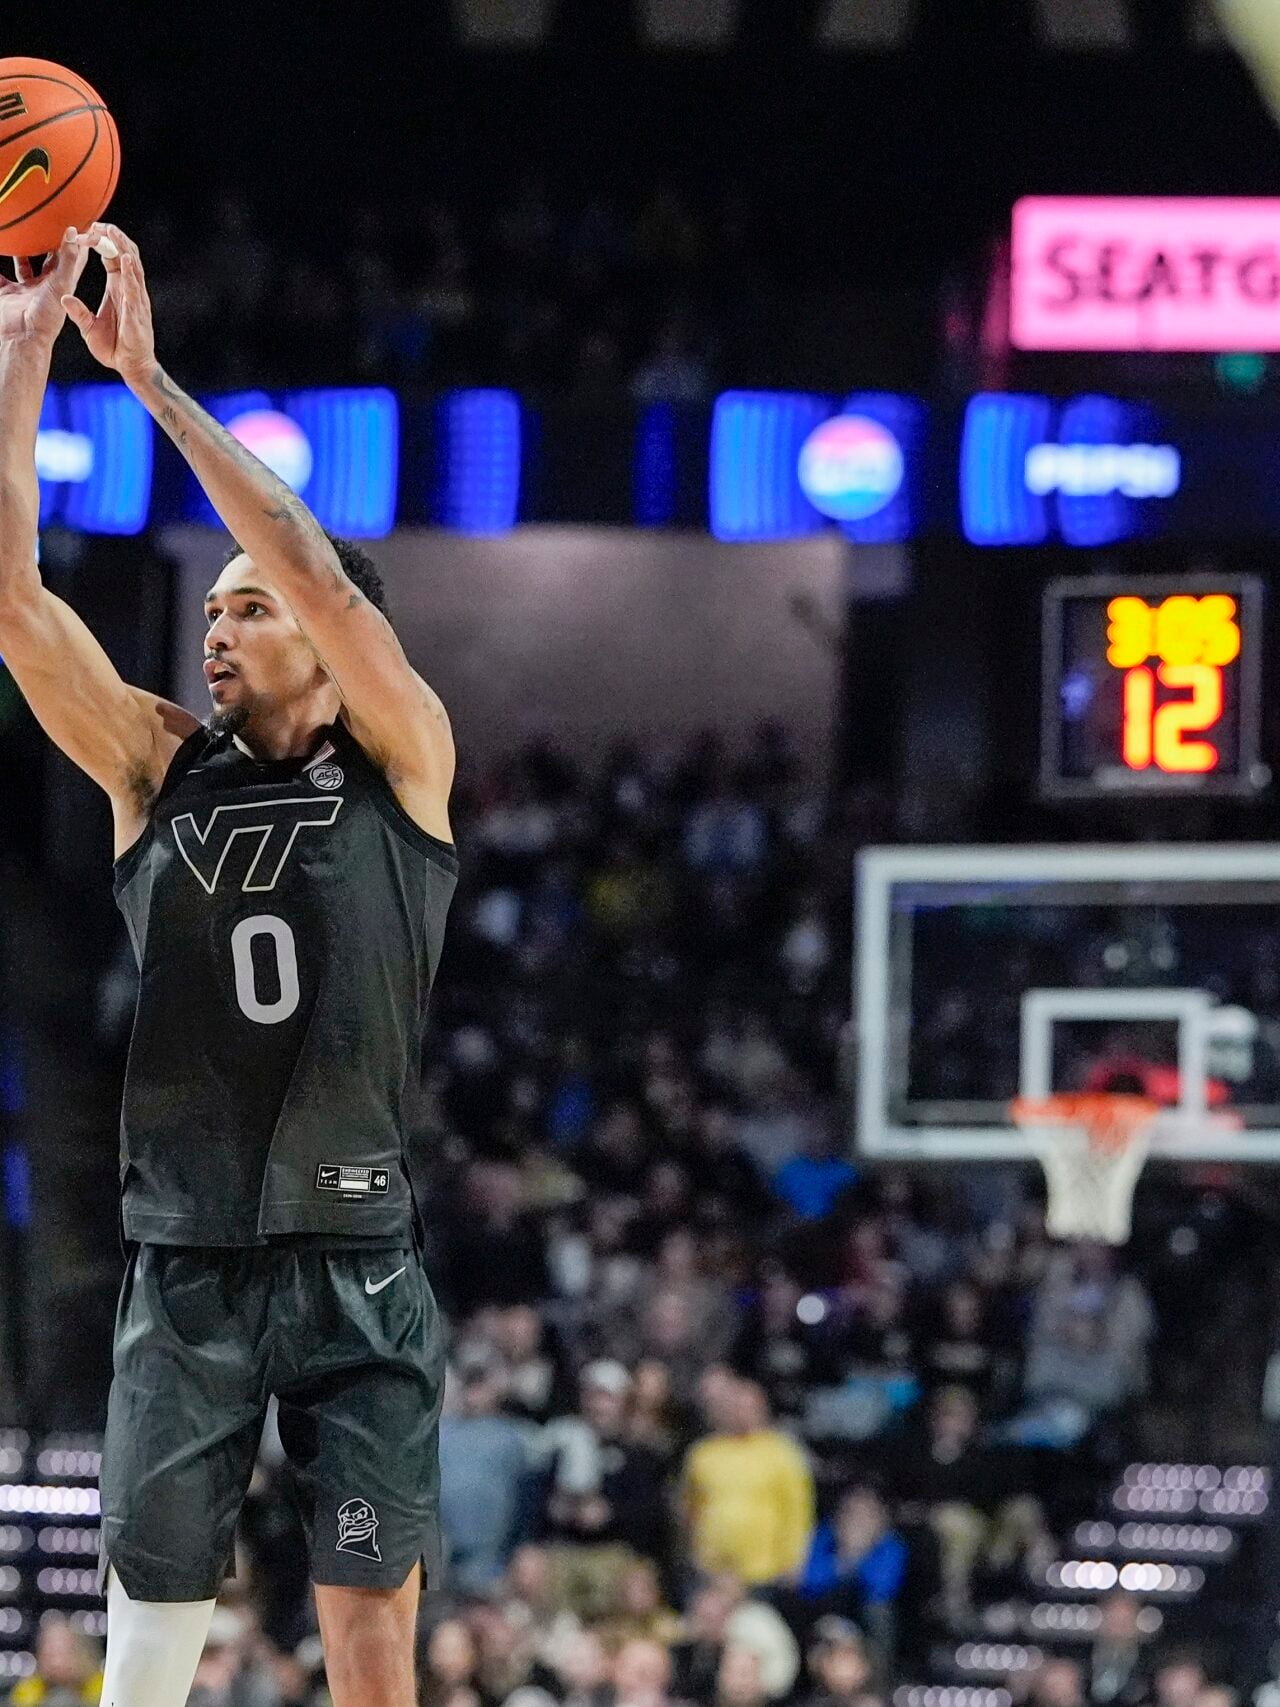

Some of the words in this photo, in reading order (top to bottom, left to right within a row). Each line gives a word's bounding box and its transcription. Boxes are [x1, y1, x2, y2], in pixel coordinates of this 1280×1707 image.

[1123, 665, 1226, 773] 12
[171, 796, 344, 895] VT
[231, 914, 300, 1025] 0
[373, 1175, 386, 1186] 46
